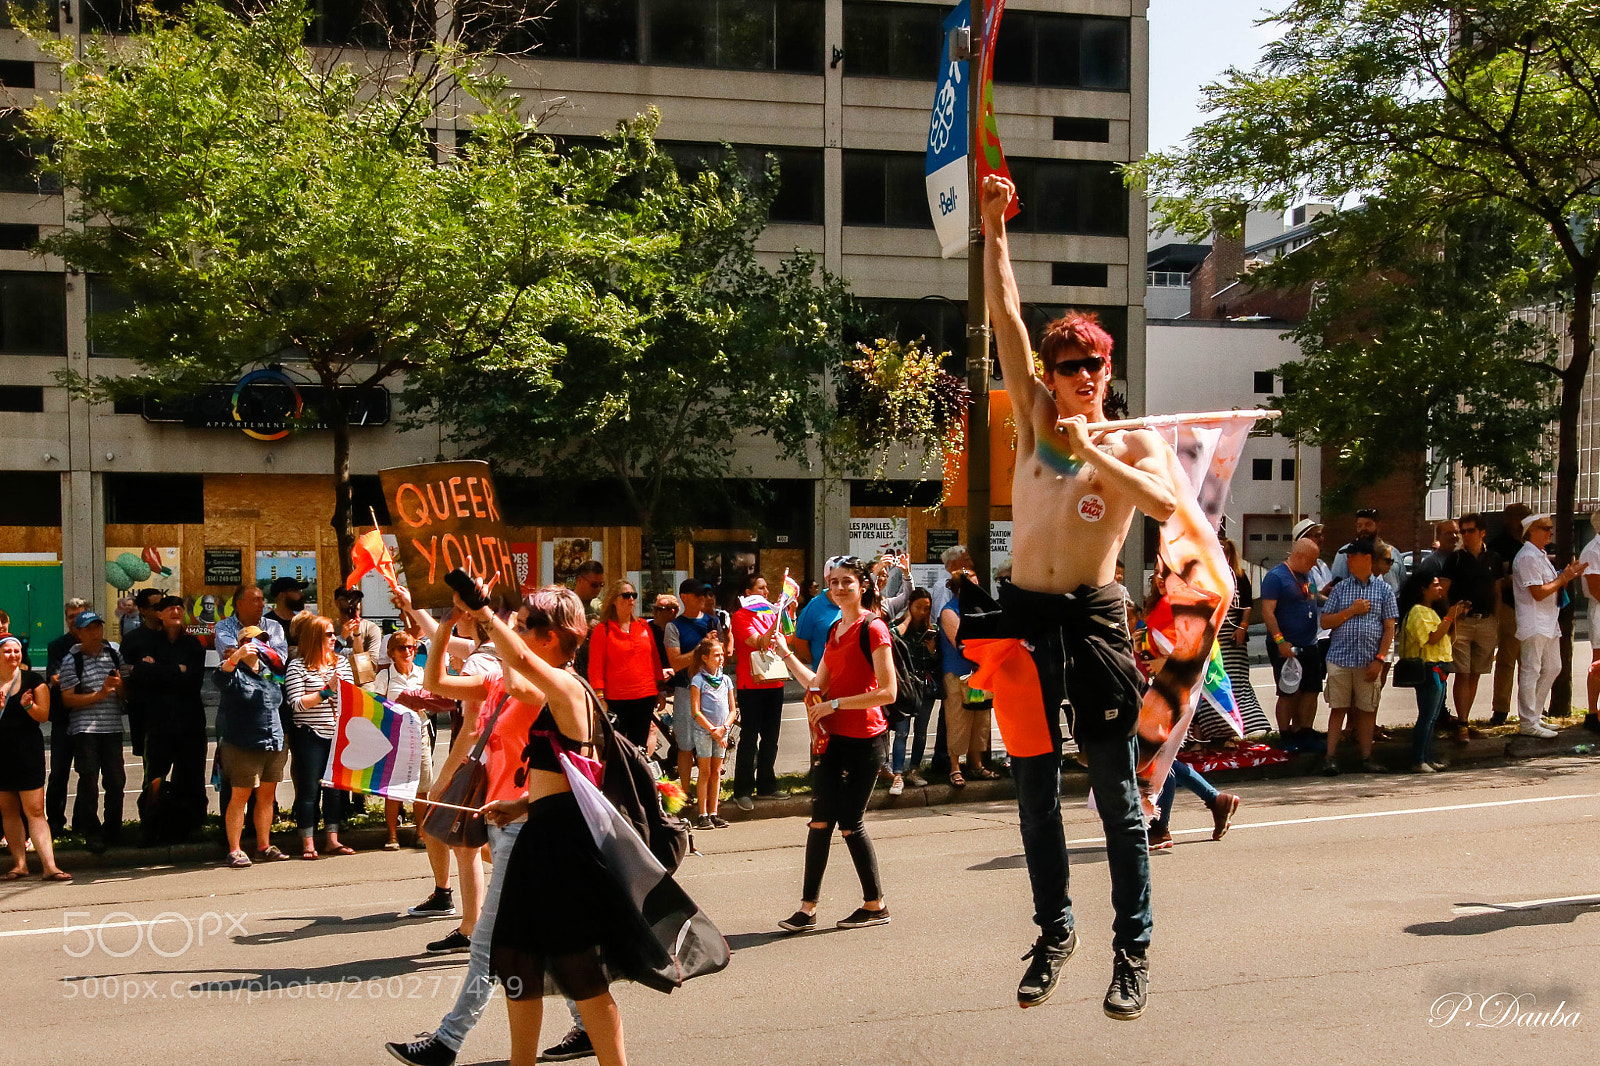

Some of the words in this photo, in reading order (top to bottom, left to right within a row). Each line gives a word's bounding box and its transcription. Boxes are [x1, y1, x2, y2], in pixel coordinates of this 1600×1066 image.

[939, 186, 956, 216] Bell
[395, 476, 500, 528] QUEER
[849, 522, 860, 530] LES
[862, 531, 875, 539] DES
[411, 533, 517, 592] YOUTH
